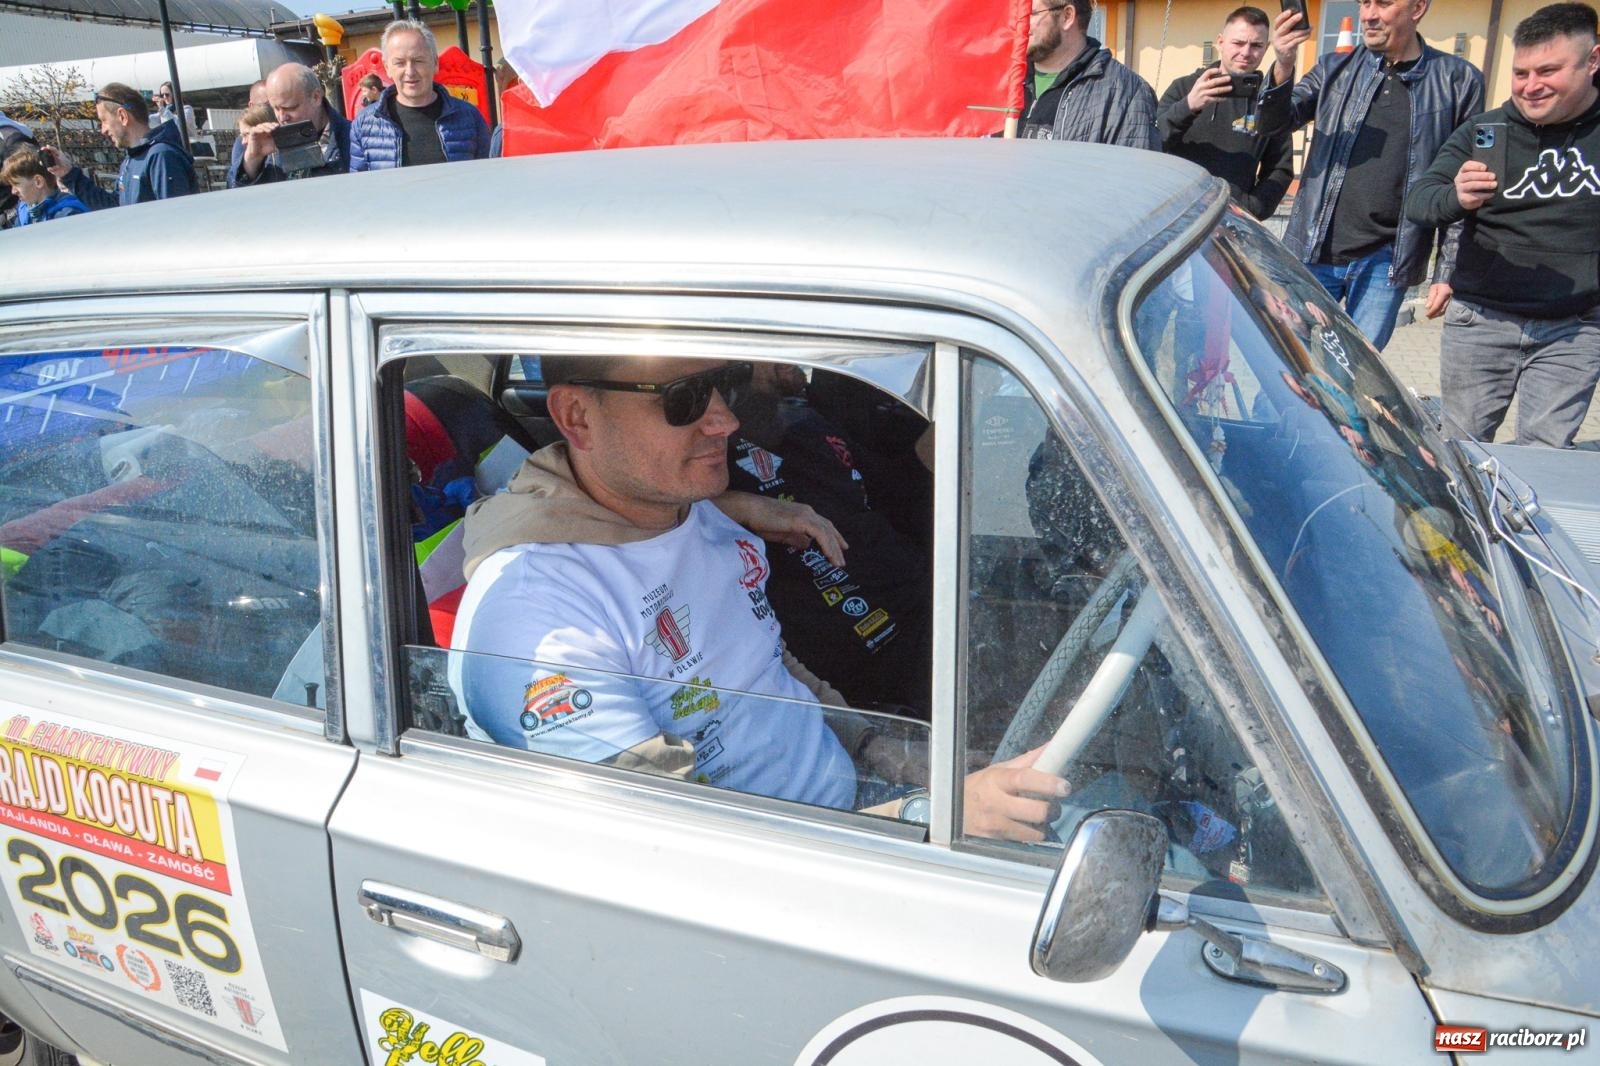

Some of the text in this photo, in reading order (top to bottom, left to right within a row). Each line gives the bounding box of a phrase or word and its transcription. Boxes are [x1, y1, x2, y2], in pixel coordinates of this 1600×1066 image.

[642, 583, 669, 604] MUZEUM
[676, 651, 704, 674] OŁAWIE
[30, 720, 181, 782] CHARYTATYWNY
[0, 744, 204, 863] RAJD KOGUTA
[0, 807, 72, 837] TAJLANDIA
[83, 832, 134, 857] OŁAWA
[147, 852, 216, 881] ZAMOŚĆ
[7, 838, 243, 975] 2026
